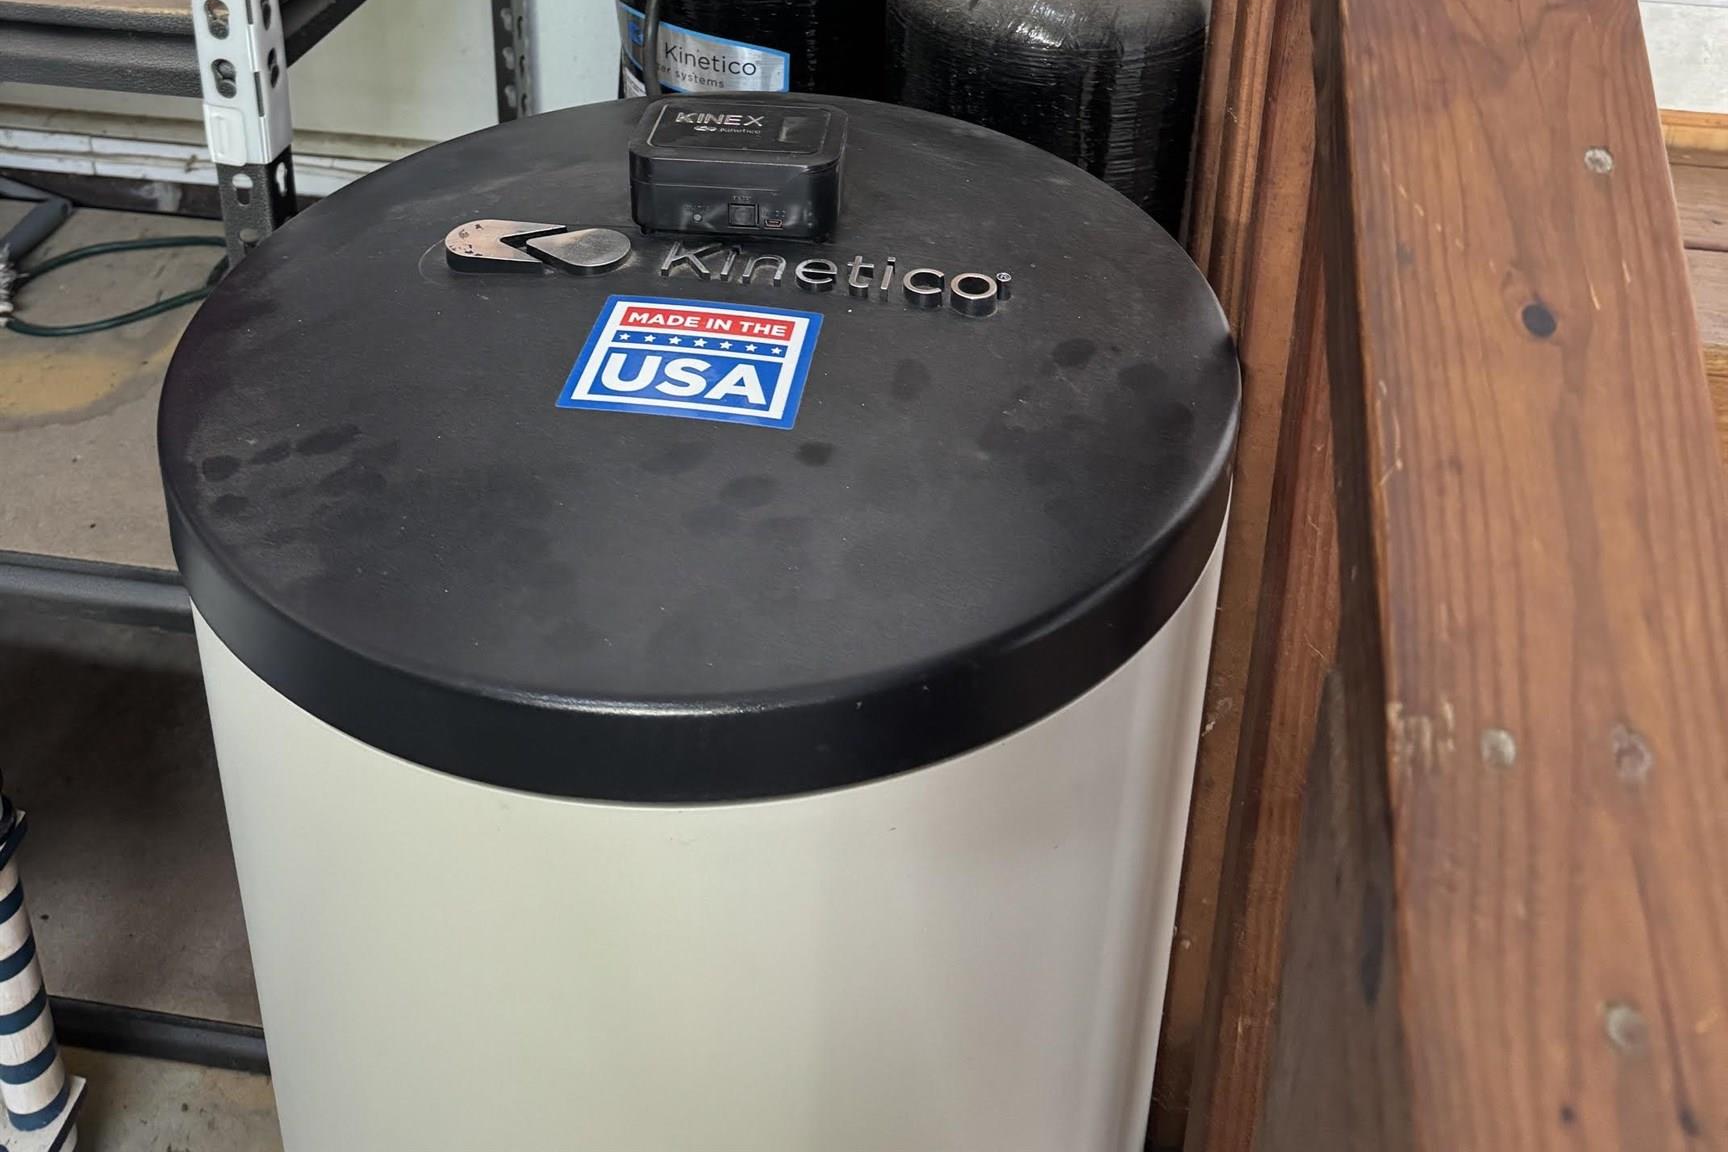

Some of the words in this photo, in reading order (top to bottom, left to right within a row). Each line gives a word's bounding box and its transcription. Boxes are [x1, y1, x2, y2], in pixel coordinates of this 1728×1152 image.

[664, 41, 757, 76] Kinetico
[674, 69, 725, 89] systems
[675, 111, 765, 127] KINEX
[627, 311, 699, 328] MADE
[705, 318, 733, 331] IN
[739, 320, 788, 337] THE
[600, 352, 767, 405] USA
